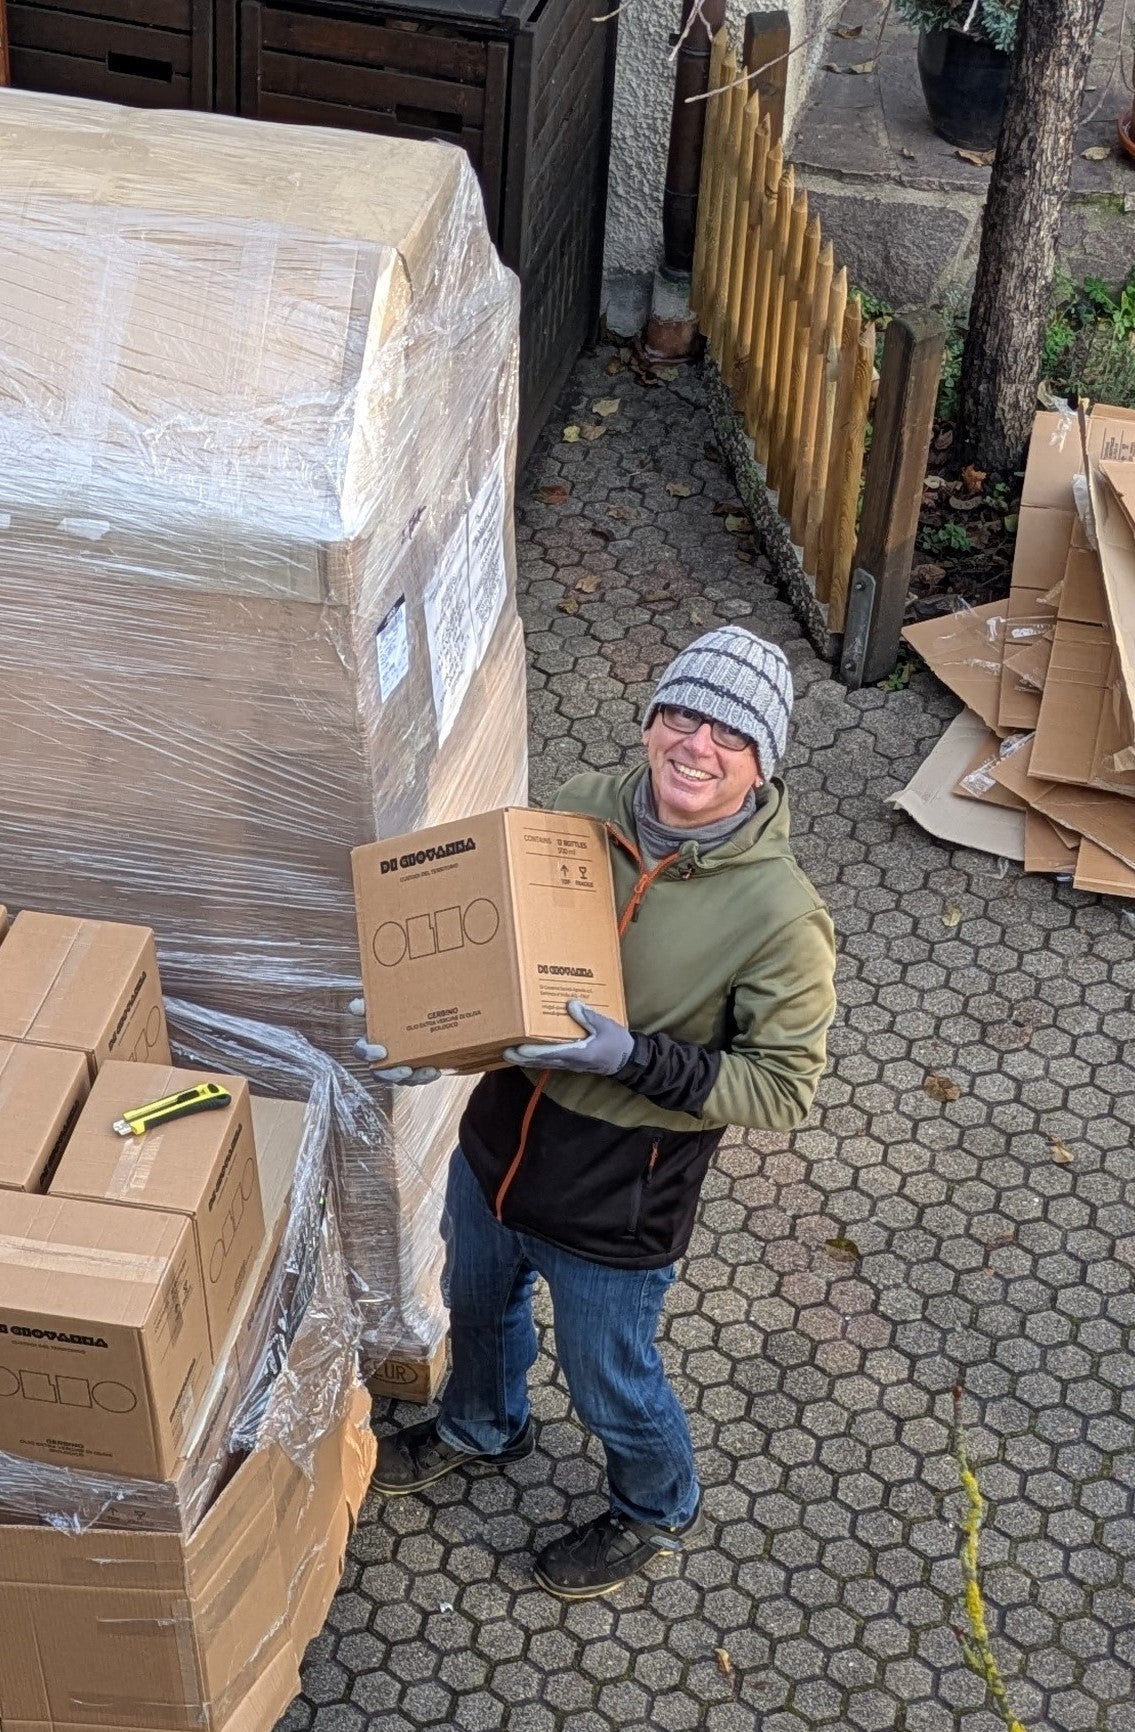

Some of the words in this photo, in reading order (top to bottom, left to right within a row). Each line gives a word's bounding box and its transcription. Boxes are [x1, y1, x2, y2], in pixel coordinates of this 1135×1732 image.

[380, 860, 398, 875] DI
[400, 836, 476, 869] GIOVANNA
[10, 1325, 109, 1349] GIOVANNA
